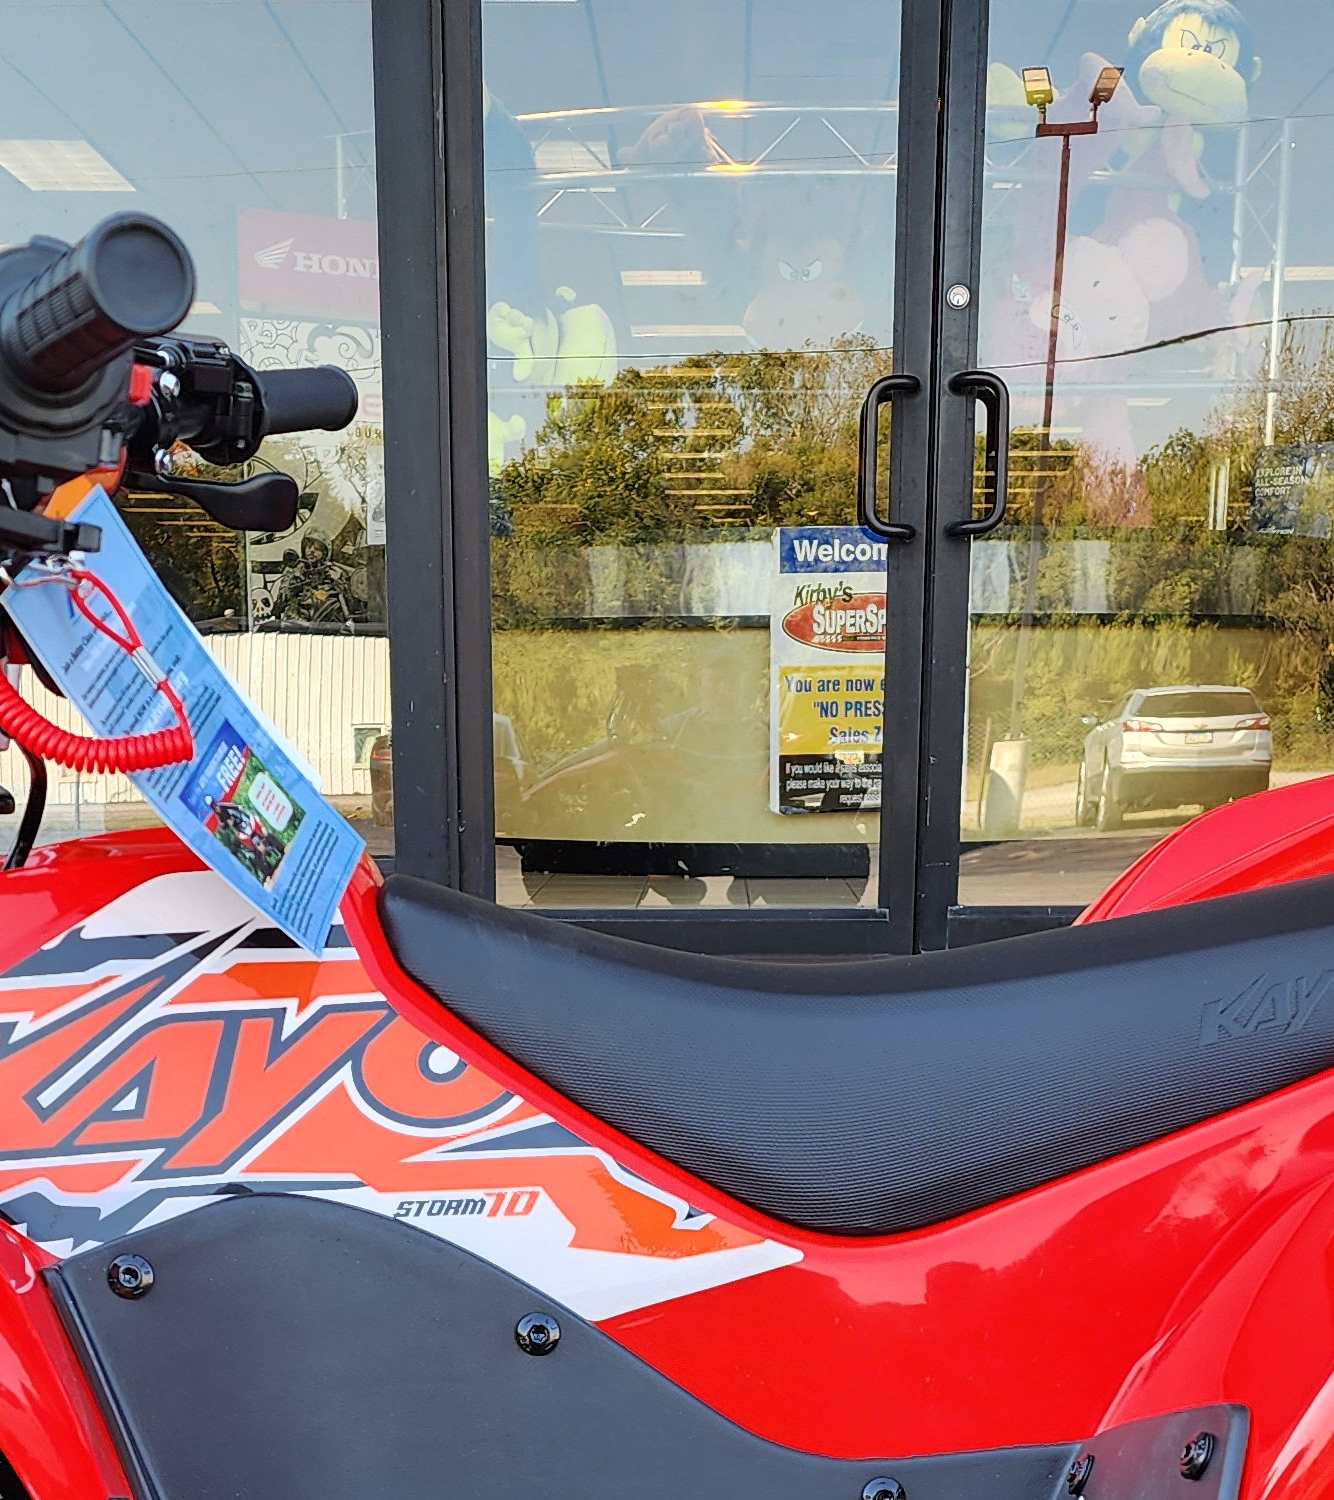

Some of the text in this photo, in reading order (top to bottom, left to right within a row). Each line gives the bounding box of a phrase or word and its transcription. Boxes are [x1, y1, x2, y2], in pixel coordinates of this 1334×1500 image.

[1255, 486, 1292, 497] COMFORT
[794, 580, 853, 609] Kirby's
[785, 675, 812, 693] You
[817, 678, 840, 692] are
[845, 678, 875, 692] now
[813, 700, 884, 718] "NO PRES
[829, 726, 869, 744] Sales
[214, 744, 246, 793] FREE!
[791, 765, 803, 777] you
[804, 762, 822, 773] would
[823, 762, 834, 773] like
[858, 763, 882, 773] associa
[786, 778, 807, 792] please
